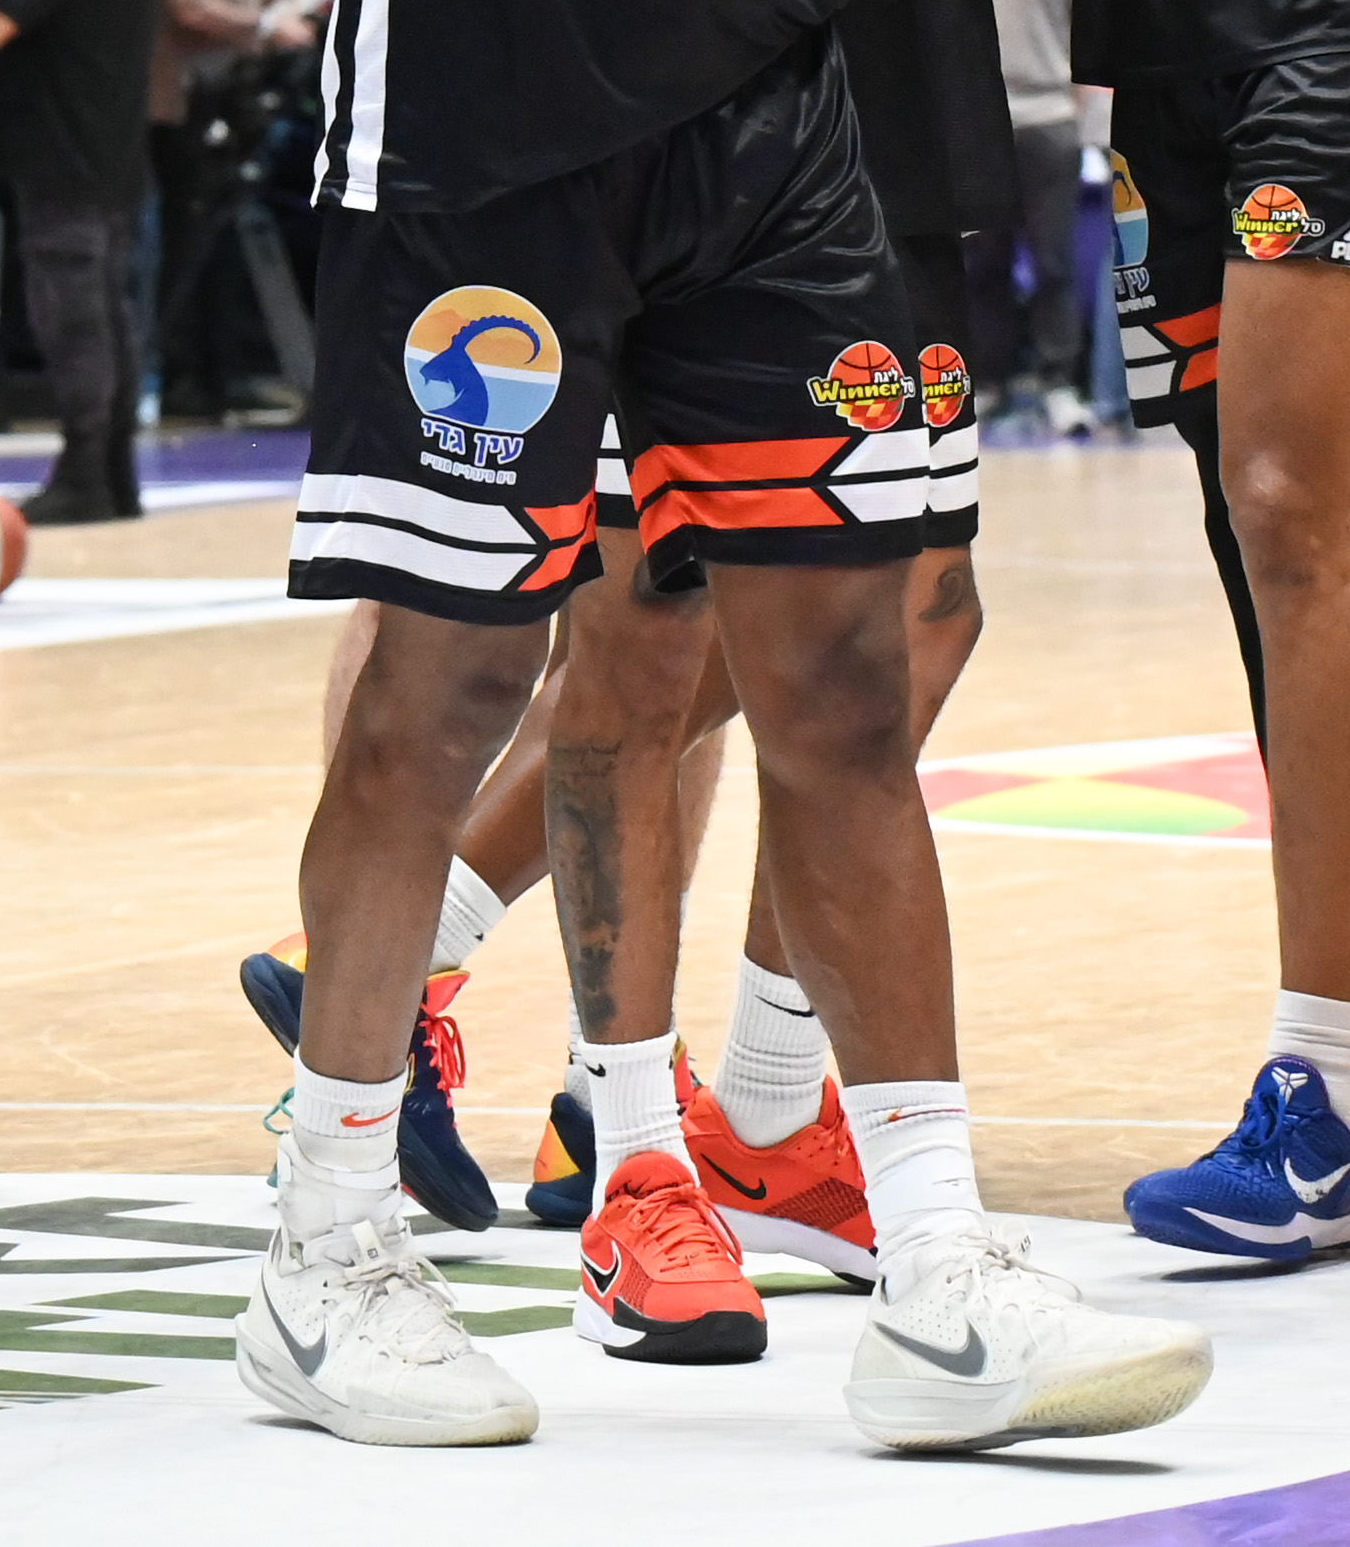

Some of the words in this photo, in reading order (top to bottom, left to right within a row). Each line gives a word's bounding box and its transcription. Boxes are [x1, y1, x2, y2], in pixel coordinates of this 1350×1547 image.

[1234, 212, 1299, 233] Winner
[1301, 217, 1321, 233] סל
[873, 366, 899, 384] ליגת
[812, 379, 901, 403] Winner
[924, 381, 962, 398] nner
[421, 418, 466, 455] גדי
[473, 432, 524, 467] עין
